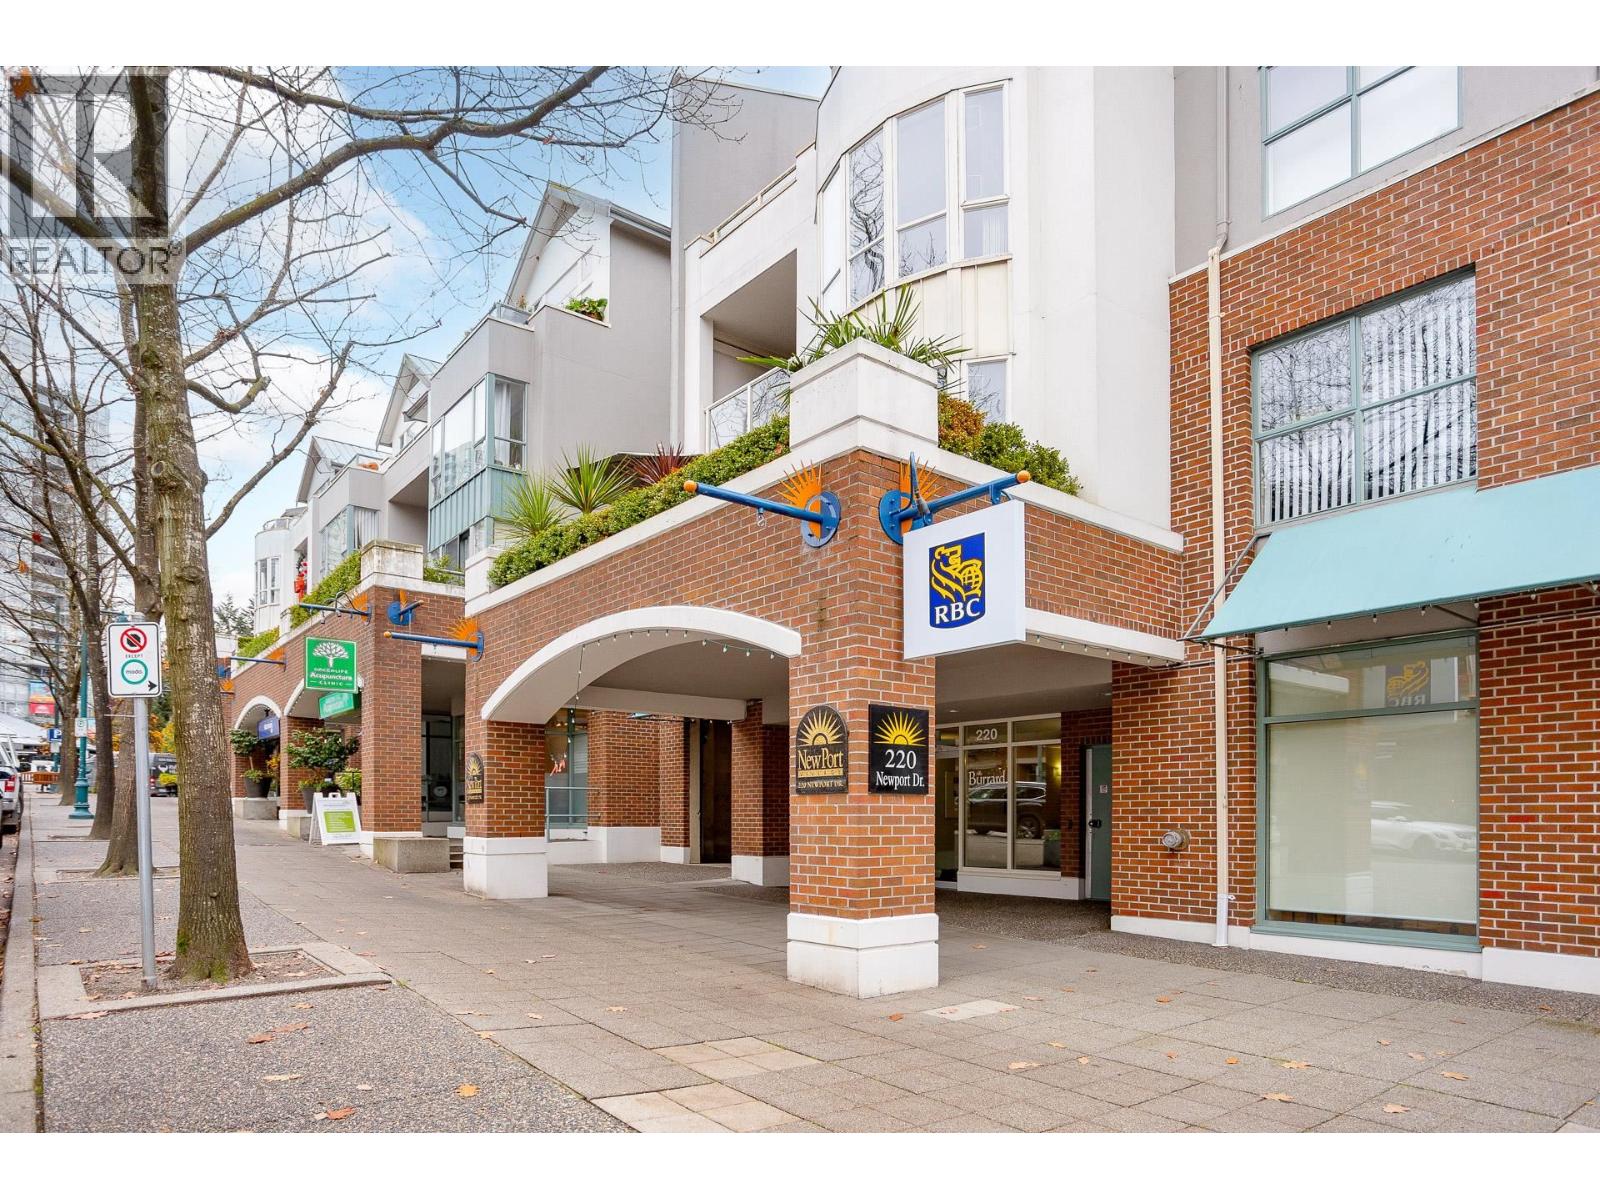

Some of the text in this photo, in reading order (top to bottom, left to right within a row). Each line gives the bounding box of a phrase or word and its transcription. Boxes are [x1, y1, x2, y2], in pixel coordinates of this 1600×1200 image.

[934, 598, 980, 625] RBC
[310, 671, 353, 682] Acupuncture
[976, 728, 998, 741] 220
[885, 749, 917, 770] 220
[876, 771, 925, 790] Newport Dr.
[968, 769, 1006, 786] Burrard
